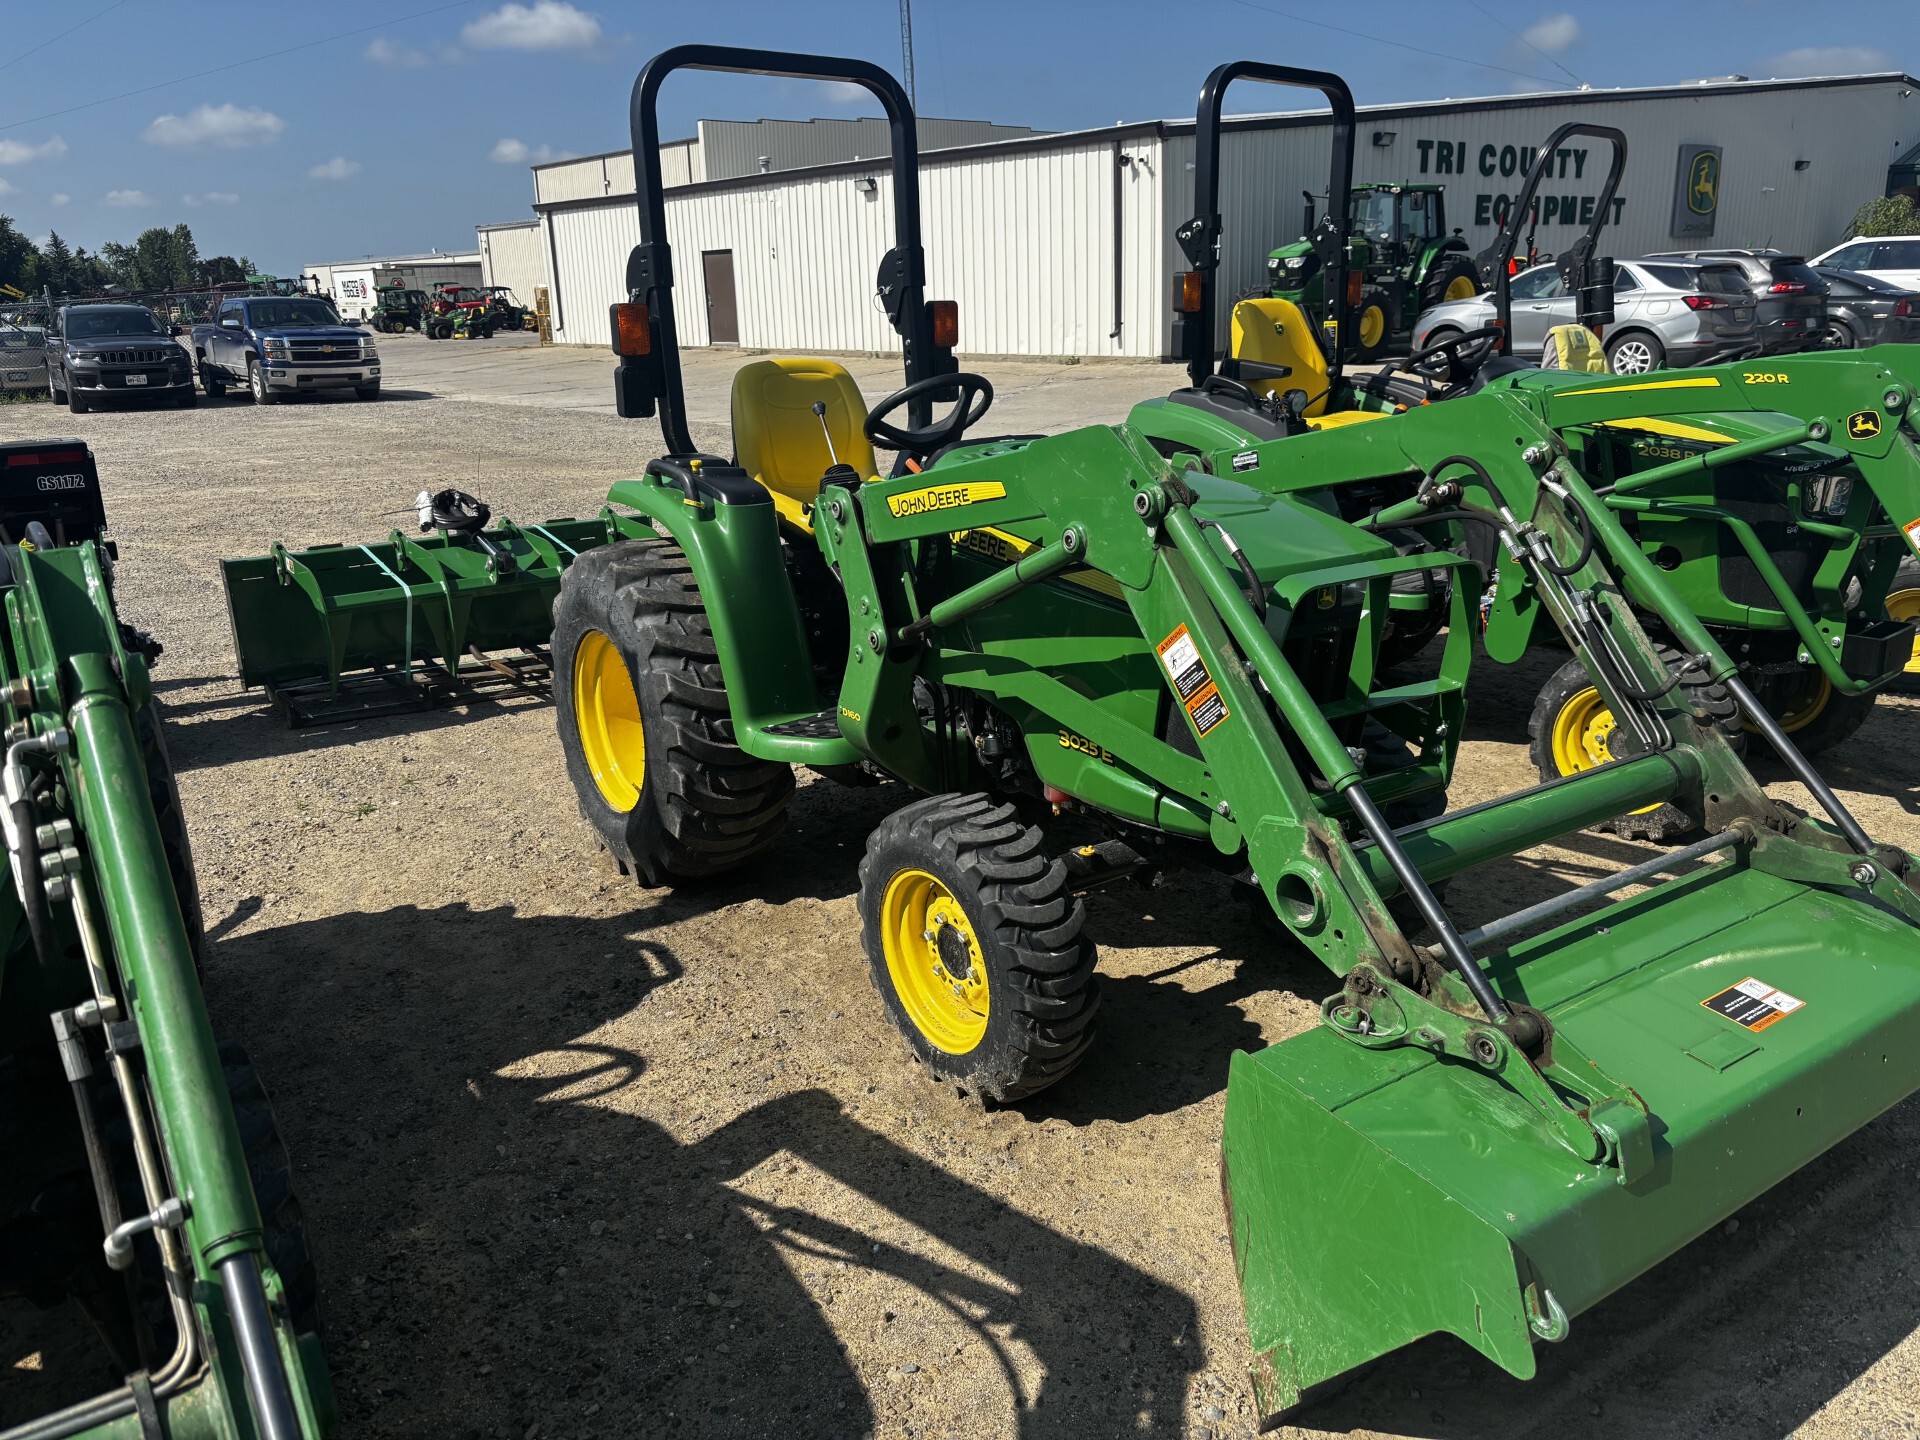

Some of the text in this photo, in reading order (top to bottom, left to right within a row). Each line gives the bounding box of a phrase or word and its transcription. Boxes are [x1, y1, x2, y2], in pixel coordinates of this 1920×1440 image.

[1417, 139, 1466, 174] TRI
[1474, 194, 1626, 226] EQIPMET
[342, 280, 358, 289] MATCO
[343, 289, 360, 298] TOOLS
[1742, 373, 1790, 384] 220 R
[1638, 444, 1681, 460] 2038
[37, 474, 85, 490] GS1172
[895, 488, 971, 515] JOHN DEERE
[1165, 628, 1184, 647] WARNING
[1193, 687, 1214, 706] WARNING
[842, 707, 861, 721] D160
[1059, 729, 1114, 764] 3025 E
